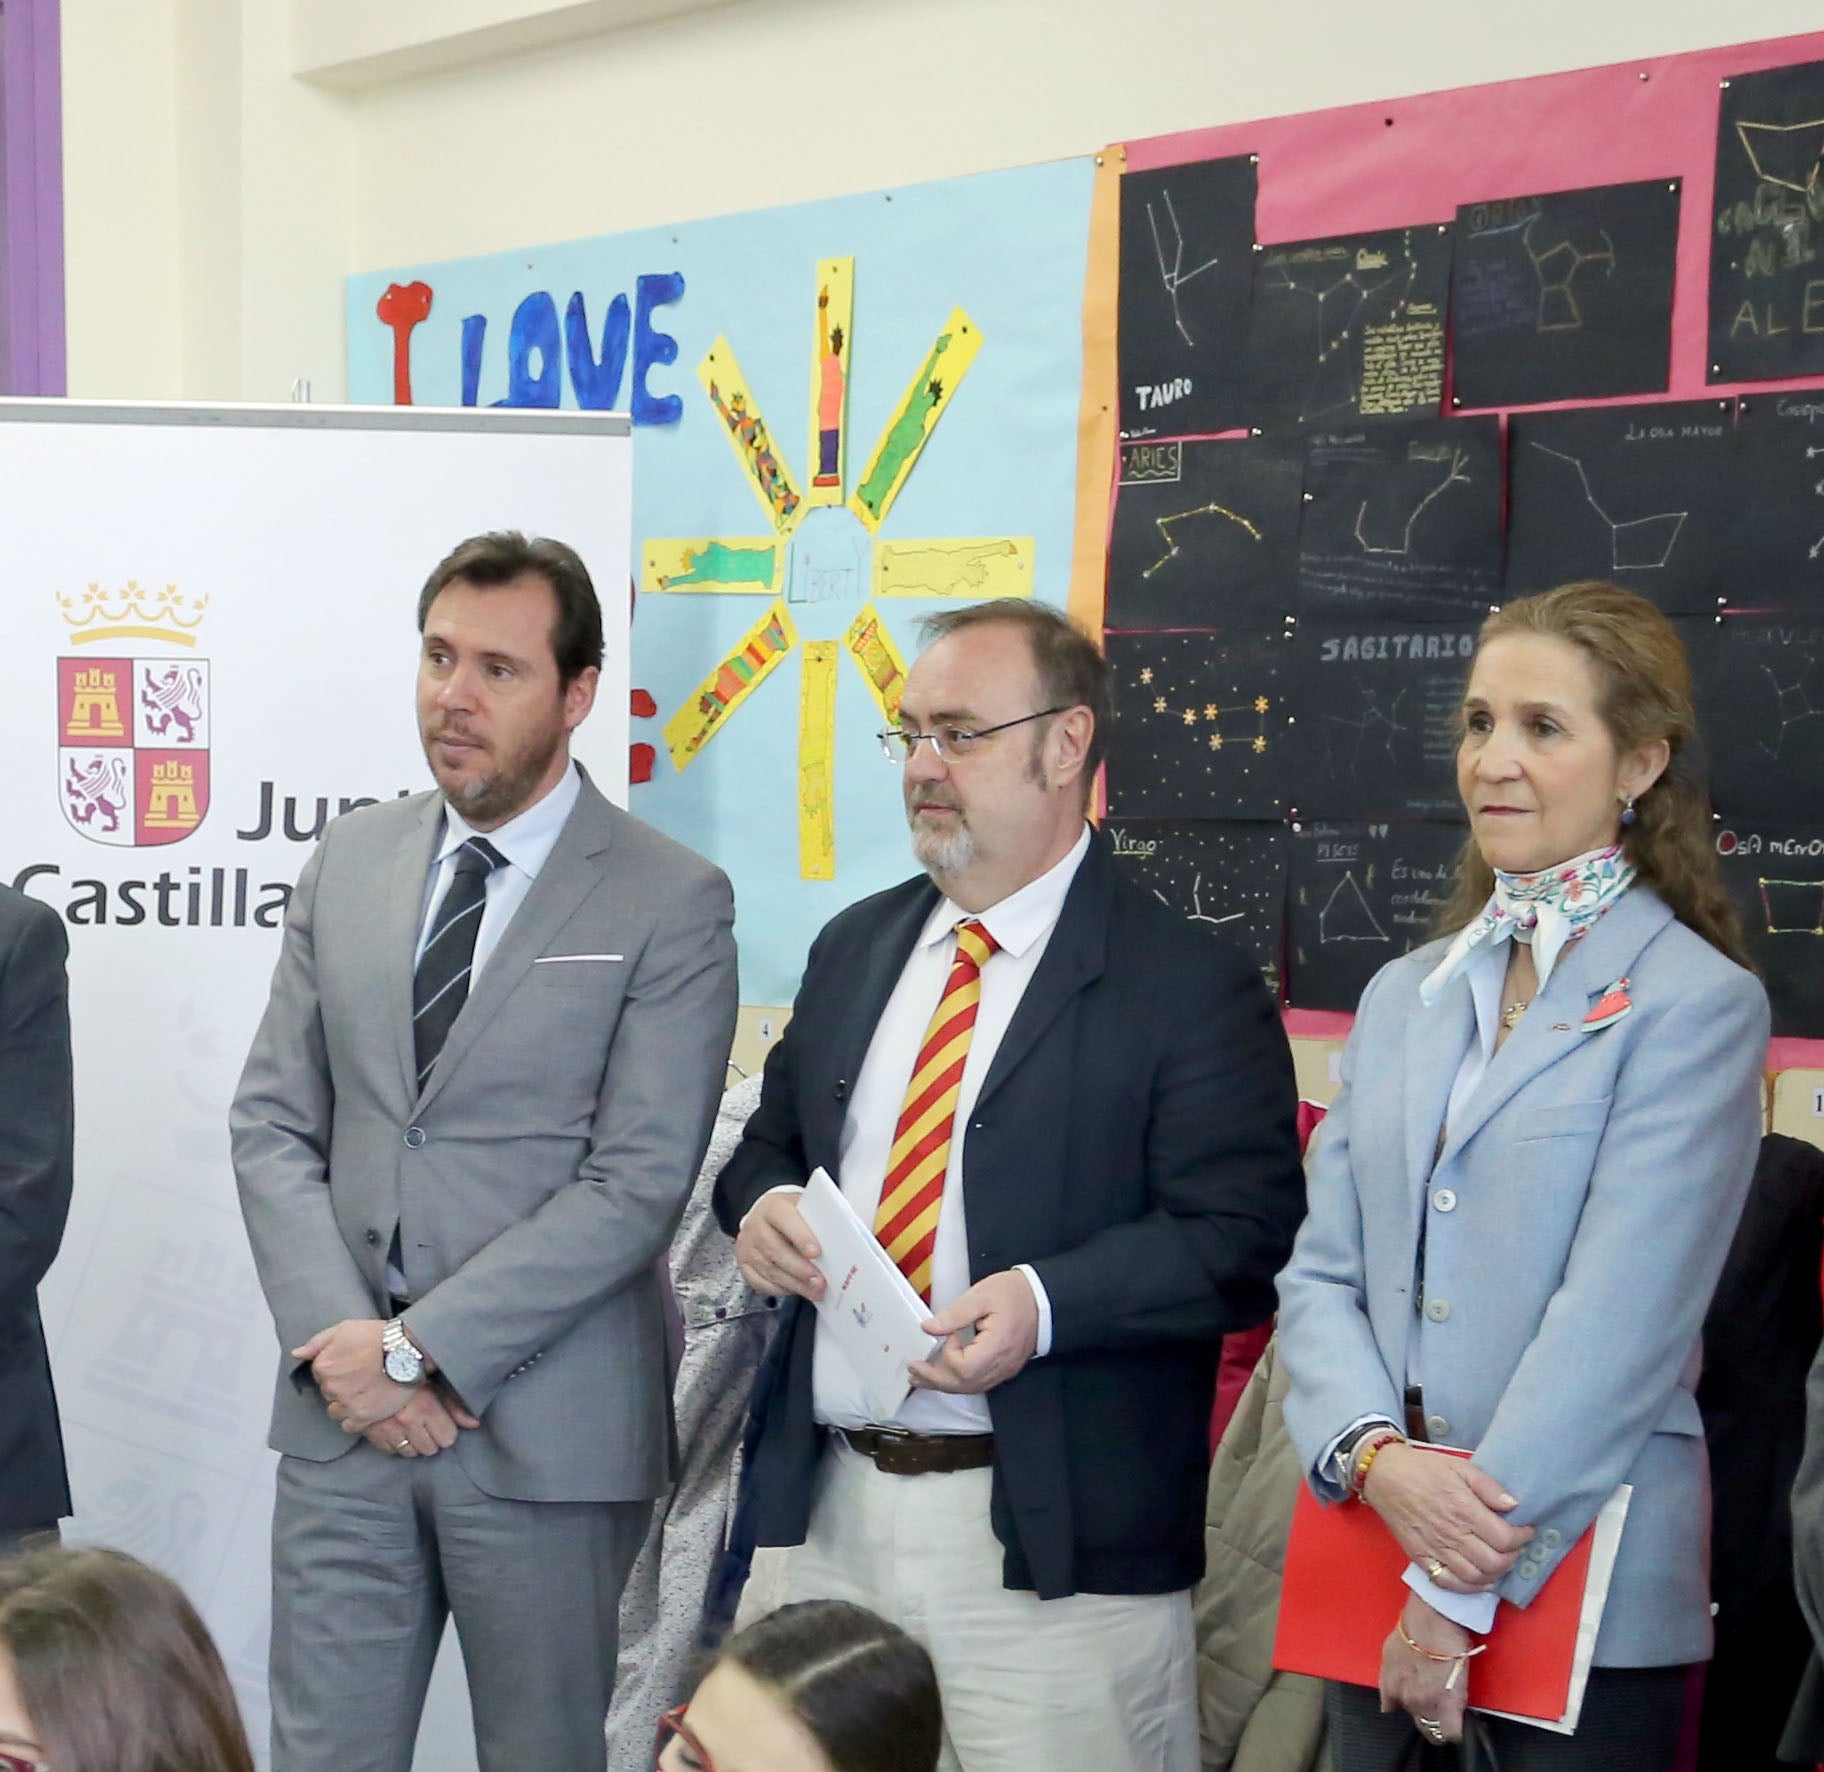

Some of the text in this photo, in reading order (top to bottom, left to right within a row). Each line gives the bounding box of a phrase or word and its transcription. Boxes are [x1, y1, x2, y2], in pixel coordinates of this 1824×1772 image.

[460, 272, 686, 426] LOVE
[1135, 377, 1193, 412] TAURO
[1129, 445, 1177, 471] ARIES
[1319, 632, 1475, 662] SAGITARIO
[1109, 827, 1158, 853] Virgo
[12, 863, 293, 928] Castilla
